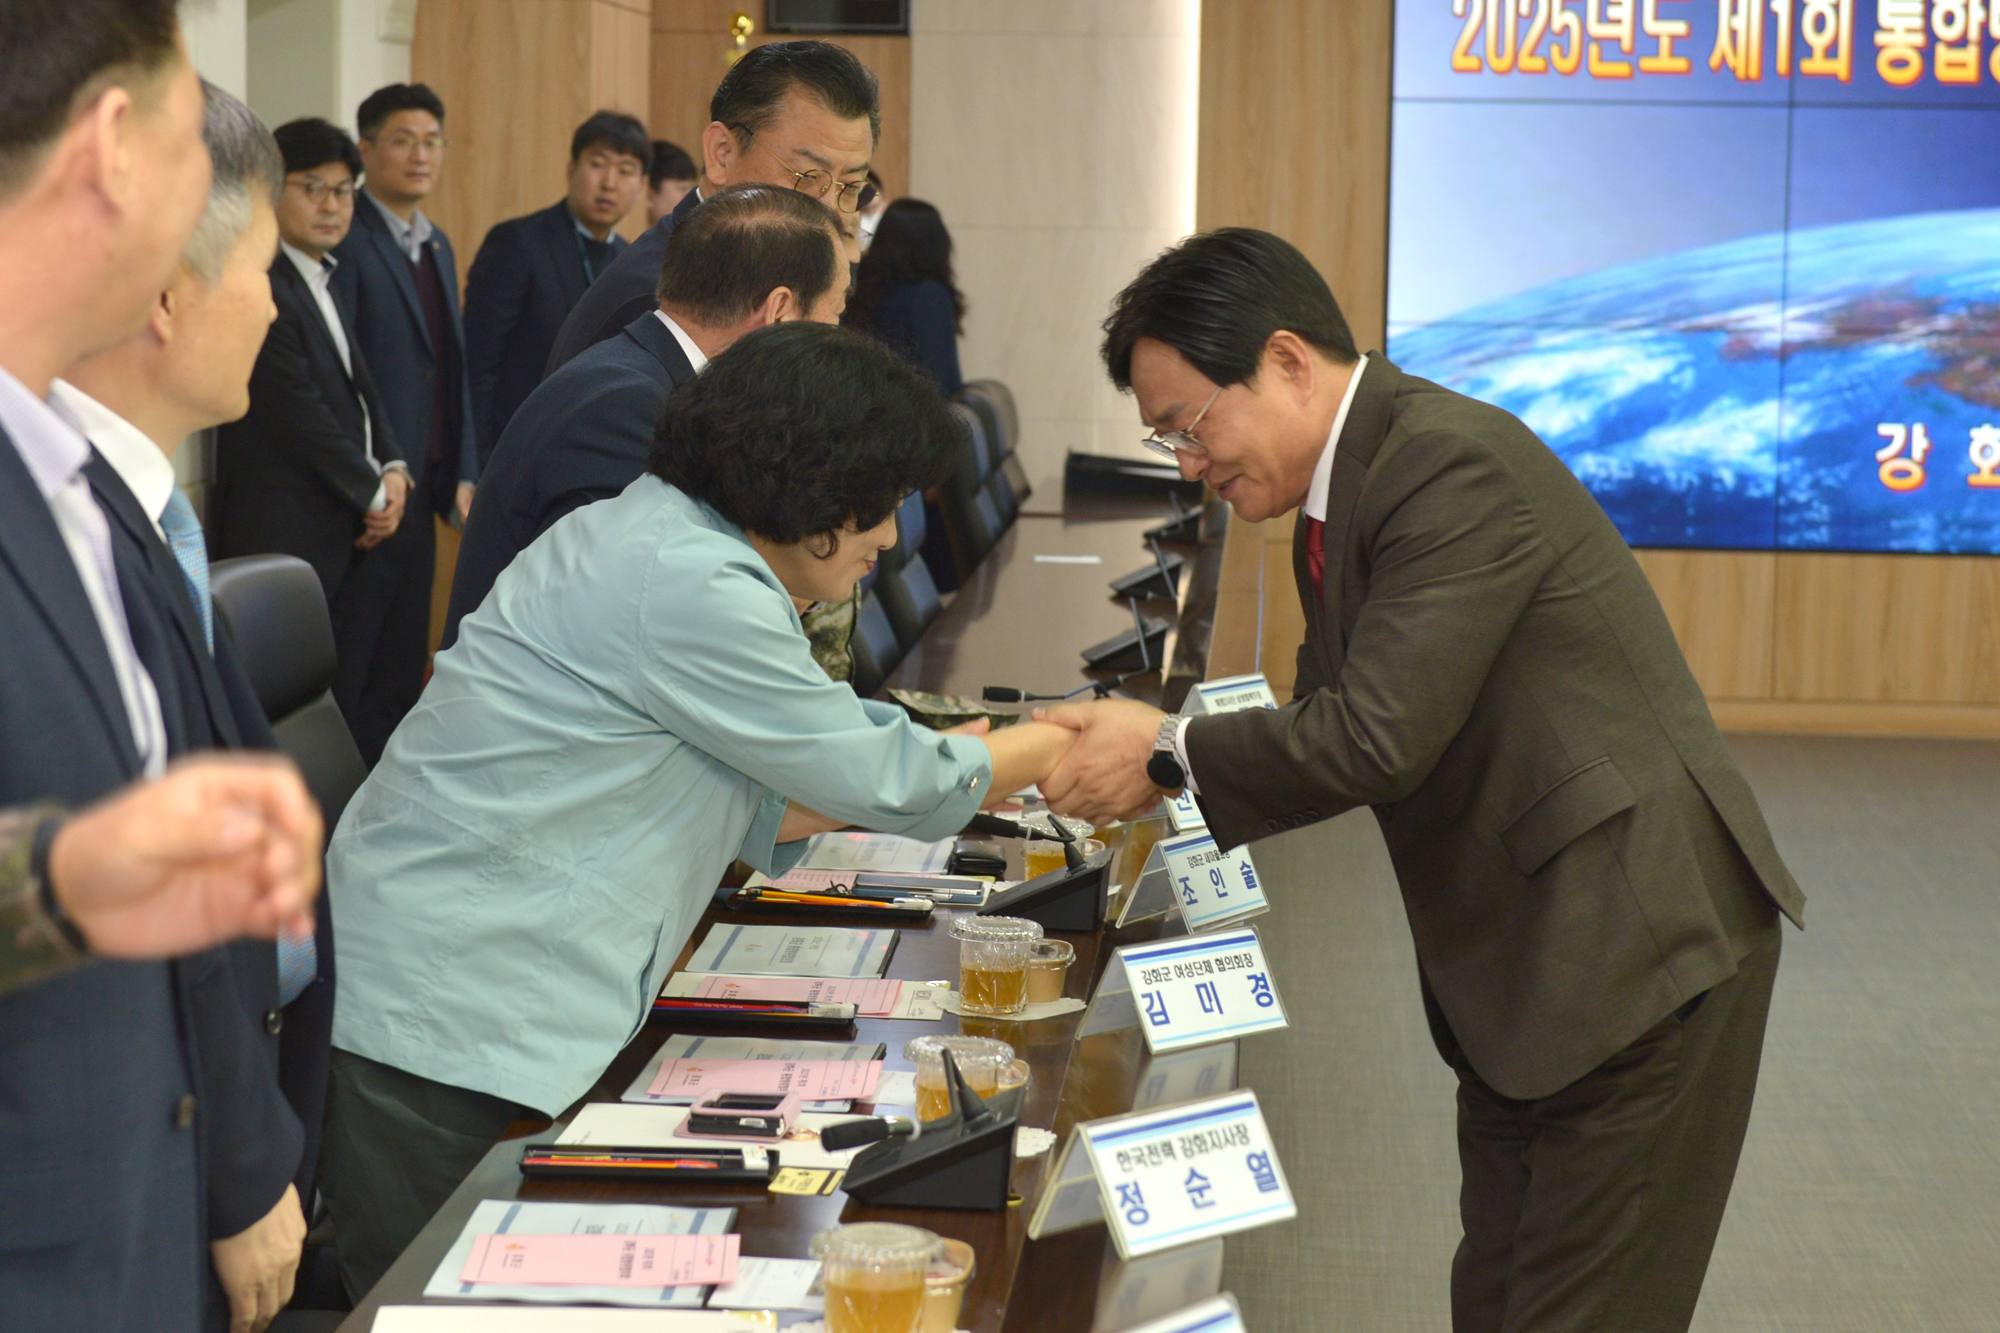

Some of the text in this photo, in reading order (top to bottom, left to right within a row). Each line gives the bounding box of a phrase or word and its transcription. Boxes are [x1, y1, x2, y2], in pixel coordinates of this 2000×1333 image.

[1451, 0, 2000, 86] 2025년도 제1회 통합
[1141, 952, 1254, 986] 강화군 여성단체 협의회장
[1116, 1123, 1250, 1172] 한국전력 강화지사장
